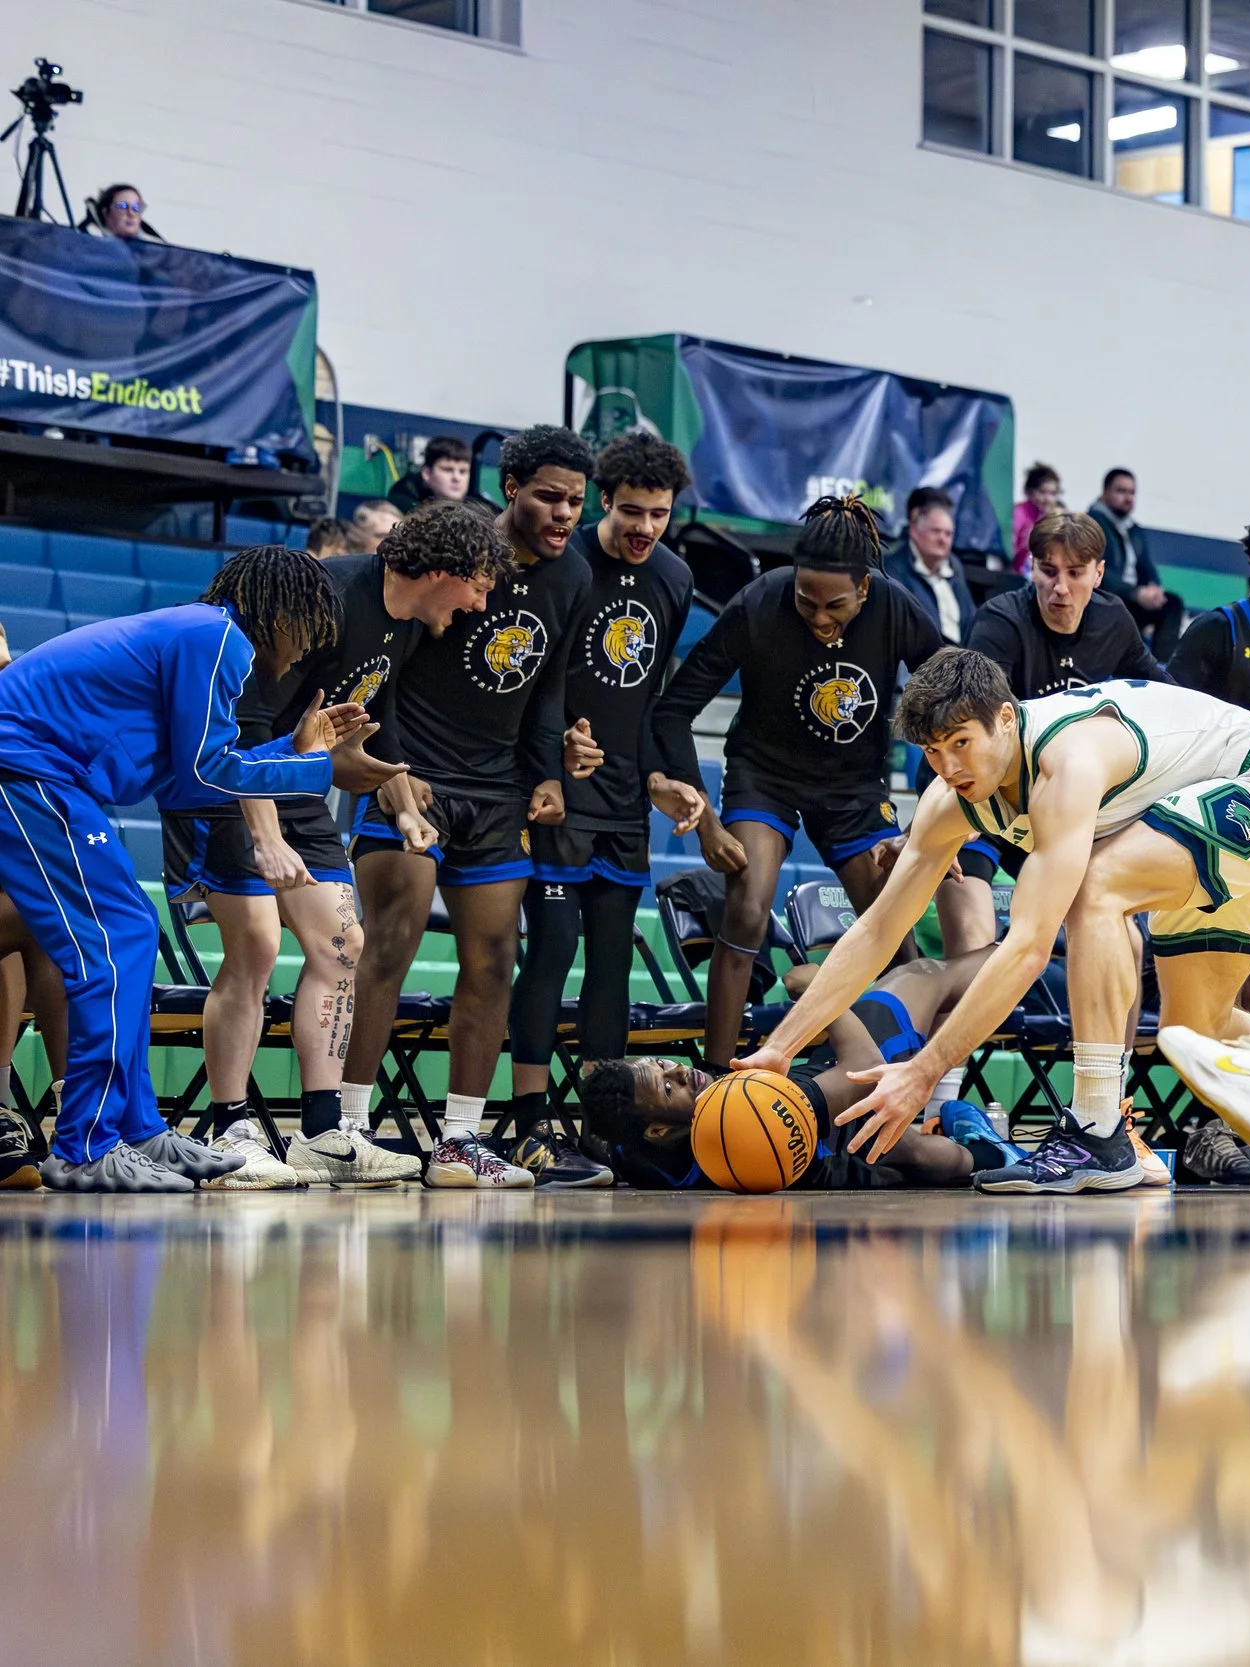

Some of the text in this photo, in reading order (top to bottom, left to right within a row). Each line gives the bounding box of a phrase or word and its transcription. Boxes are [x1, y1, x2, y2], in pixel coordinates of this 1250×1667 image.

[326, 656, 380, 707] ASKETBALL
[818, 887, 853, 908] GUL
[771, 1098, 808, 1178] Wilson
